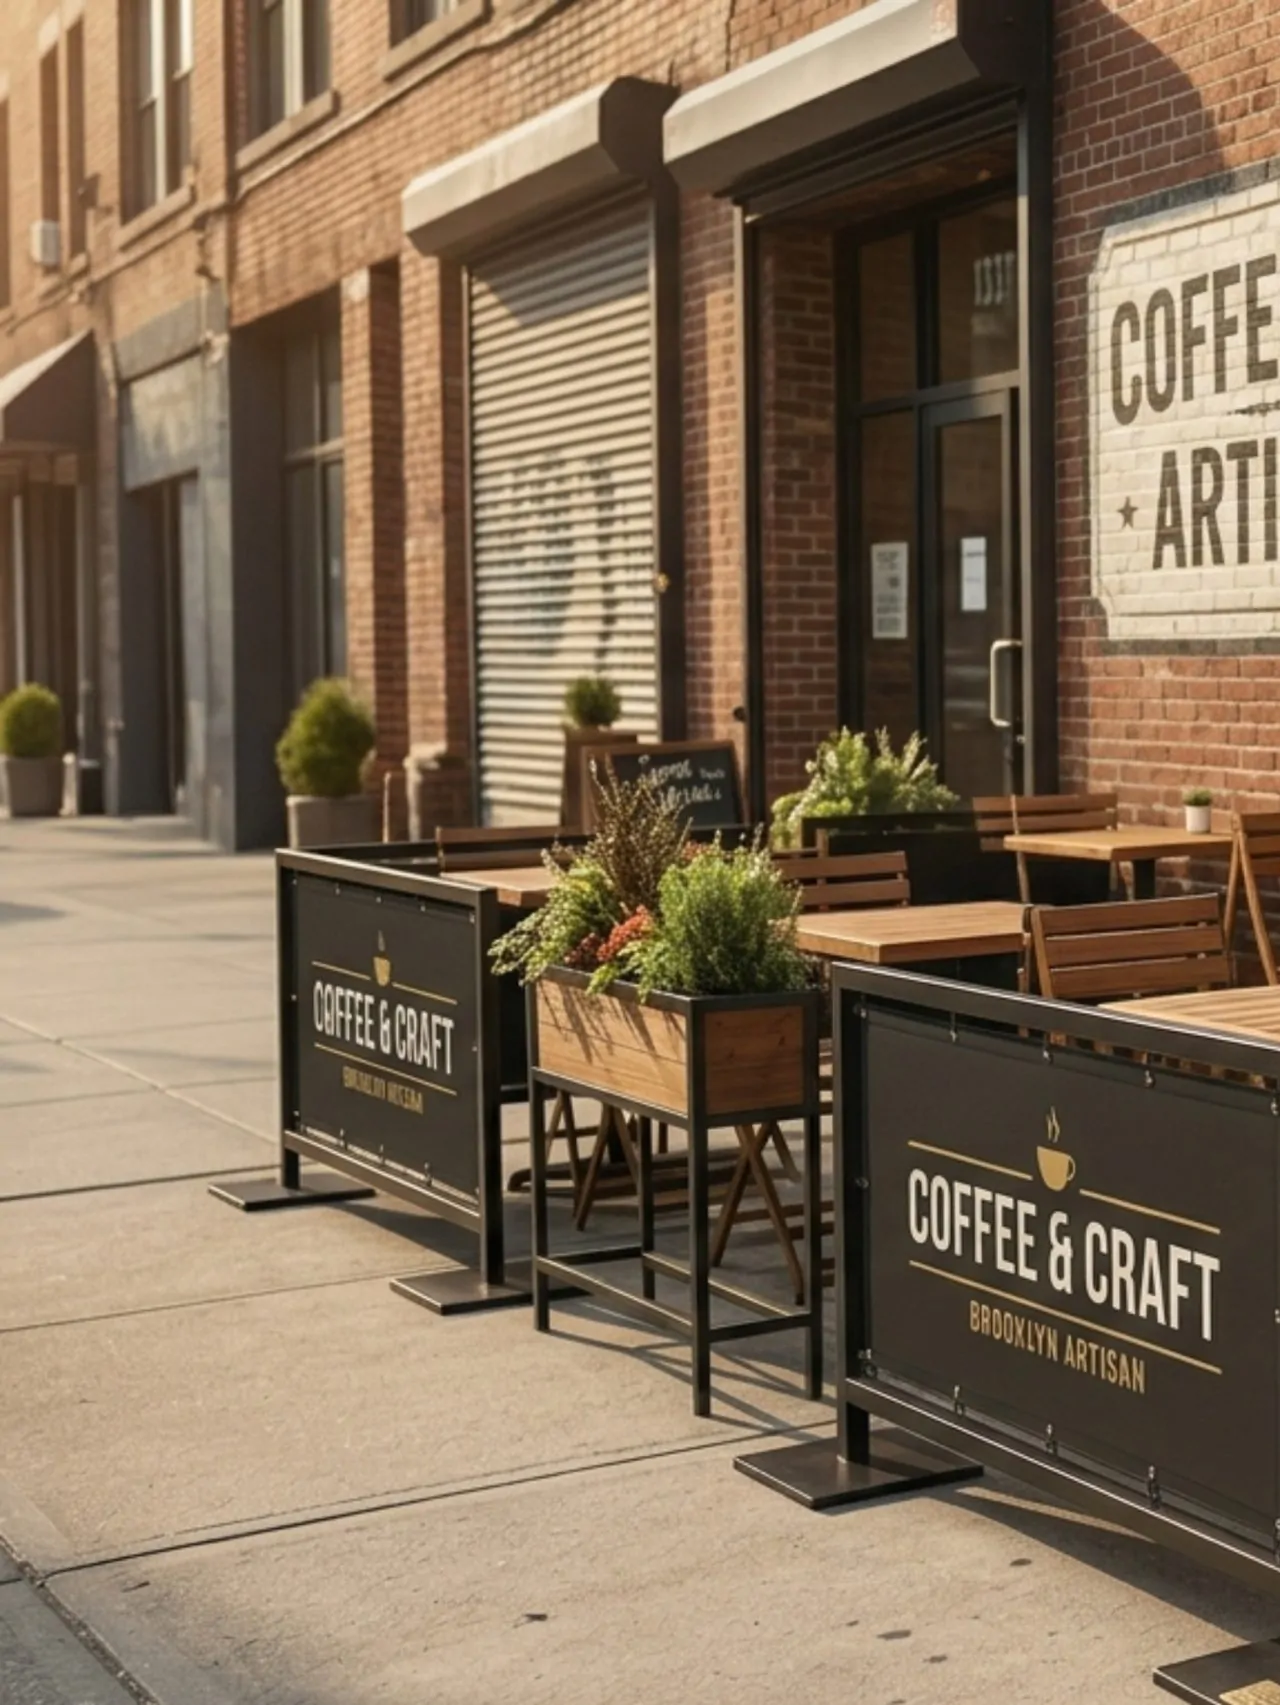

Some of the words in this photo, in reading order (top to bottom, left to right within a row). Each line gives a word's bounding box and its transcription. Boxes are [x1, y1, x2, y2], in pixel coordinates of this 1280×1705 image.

[313, 980, 375, 1050] COFFEE
[379, 1000, 391, 1055] &
[395, 1004, 454, 1075] CRAFT
[908, 1168, 1038, 1281] COFFEE
[1049, 1211, 1073, 1295] &
[1085, 1221, 1220, 1341] CRAFT
[1064, 1334, 1145, 1394] ARTISAN
